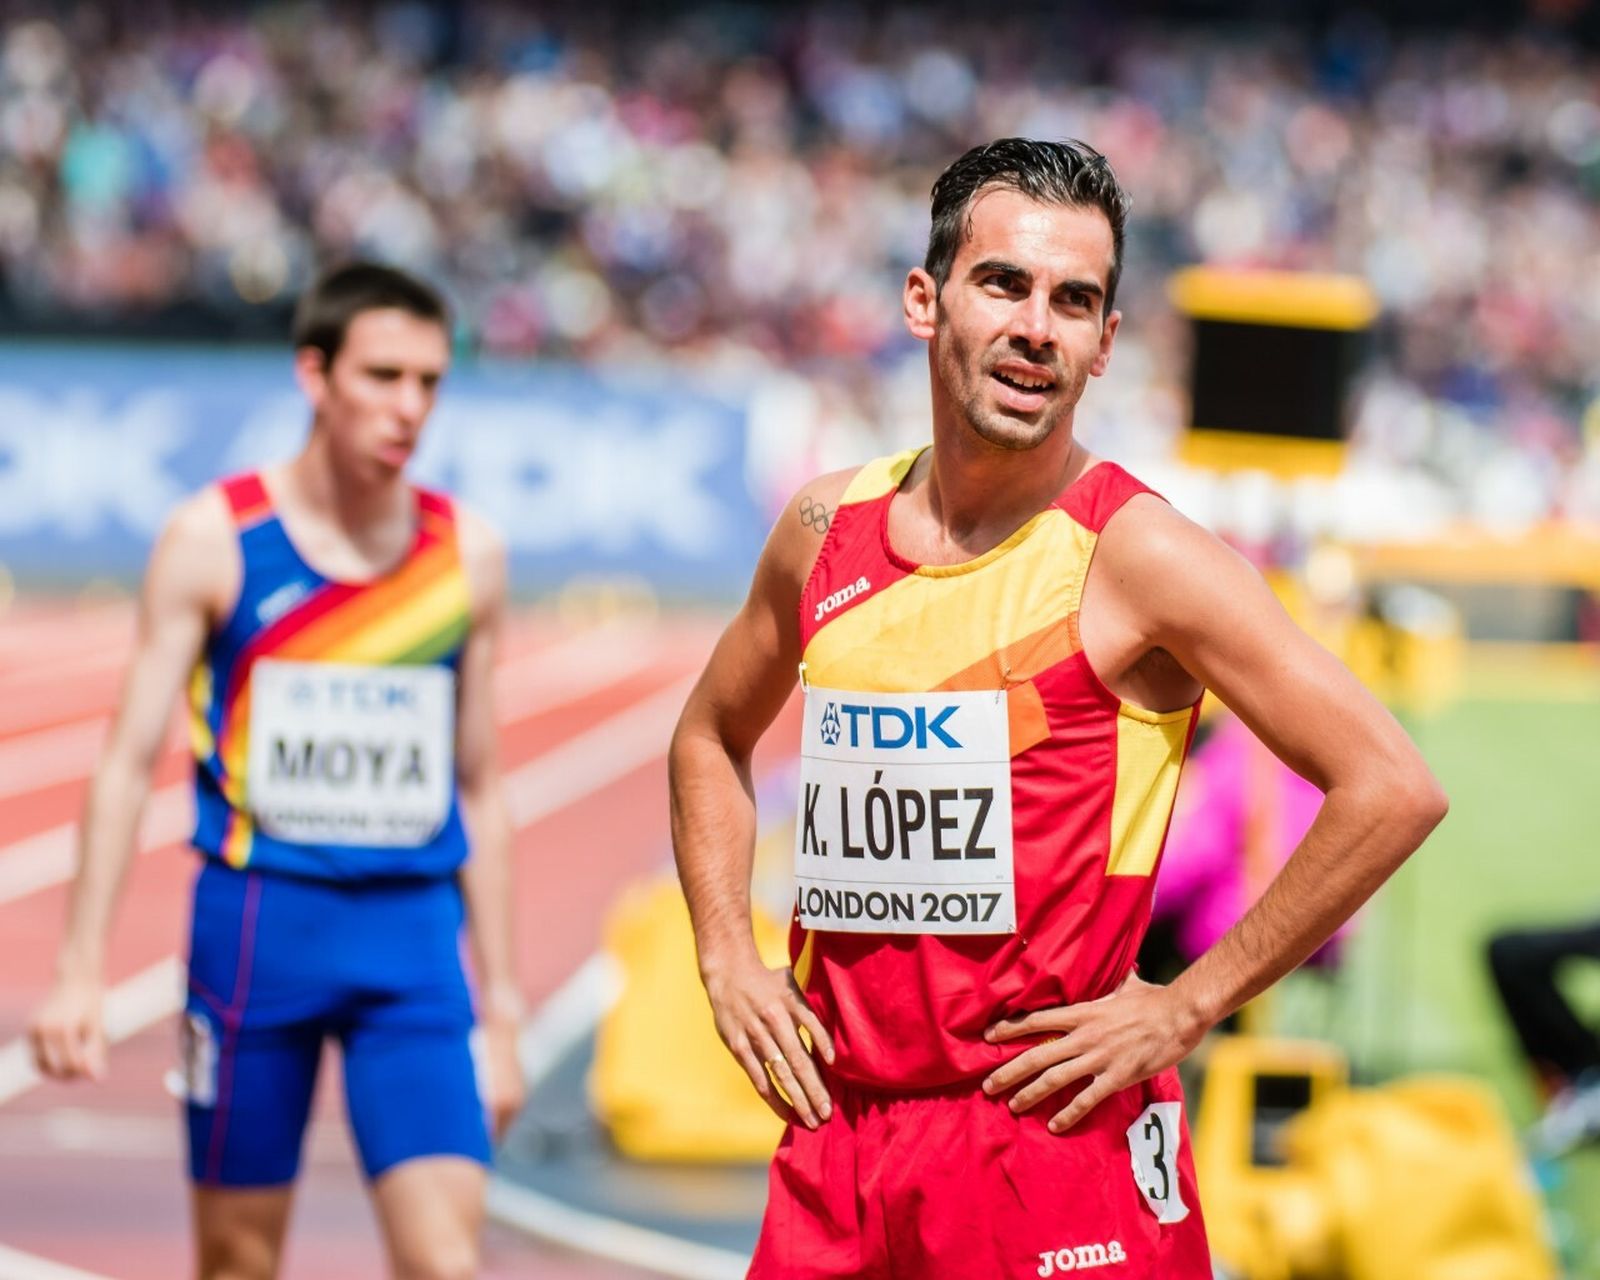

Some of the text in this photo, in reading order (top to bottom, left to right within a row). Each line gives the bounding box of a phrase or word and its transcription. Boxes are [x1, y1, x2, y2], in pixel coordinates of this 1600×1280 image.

[841, 703, 964, 749] TDK
[269, 736, 427, 789] MOYA
[801, 770, 997, 861] K. LÓPEZ
[798, 886, 1003, 923] LONDON 2017
[1144, 1112, 1170, 1201] 3
